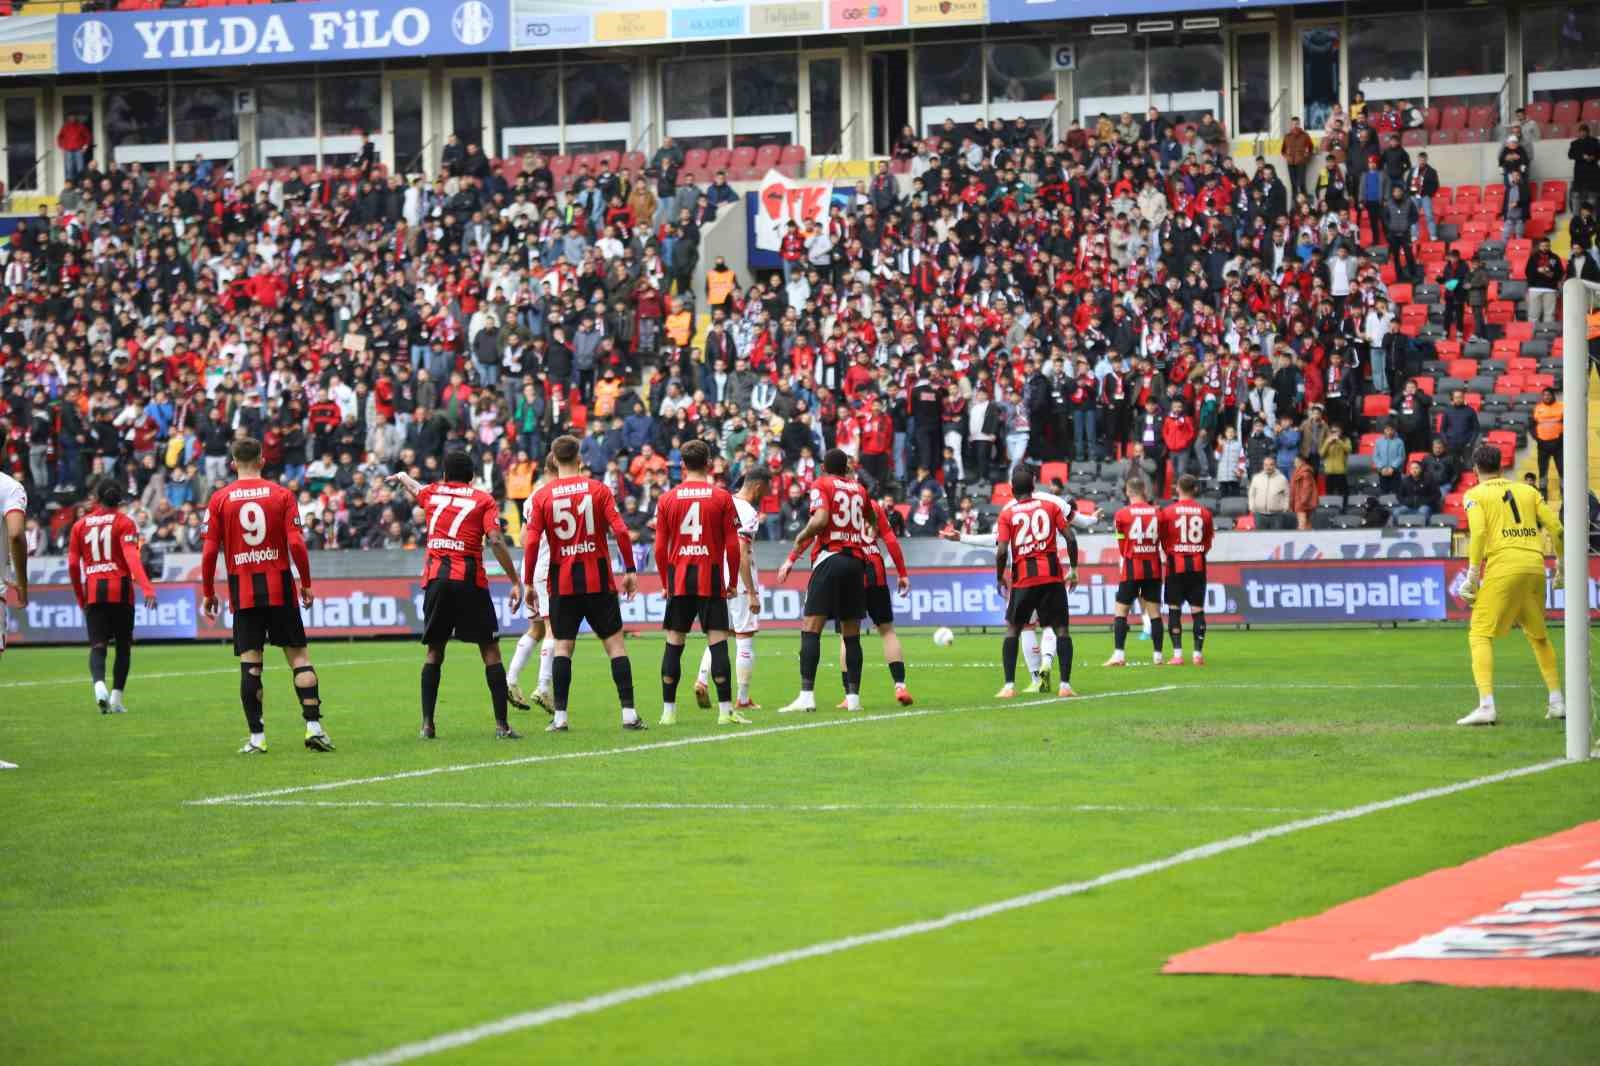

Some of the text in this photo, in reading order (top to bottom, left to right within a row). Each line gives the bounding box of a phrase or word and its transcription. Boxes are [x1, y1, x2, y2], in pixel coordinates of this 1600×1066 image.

[134, 14, 294, 59] YILDA
[1056, 47, 1071, 66] G
[239, 501, 267, 546] 9
[427, 494, 477, 539] 77
[552, 494, 595, 540] 51
[680, 501, 703, 542] 4
[832, 490, 863, 531] 36
[1502, 489, 1521, 524] 1
[84, 524, 113, 562] 11
[1011, 508, 1051, 546] 20
[1128, 515, 1158, 544] 44
[1174, 515, 1204, 544] 18
[678, 545, 710, 556] ARDA
[1246, 574, 1441, 615] transpalet
